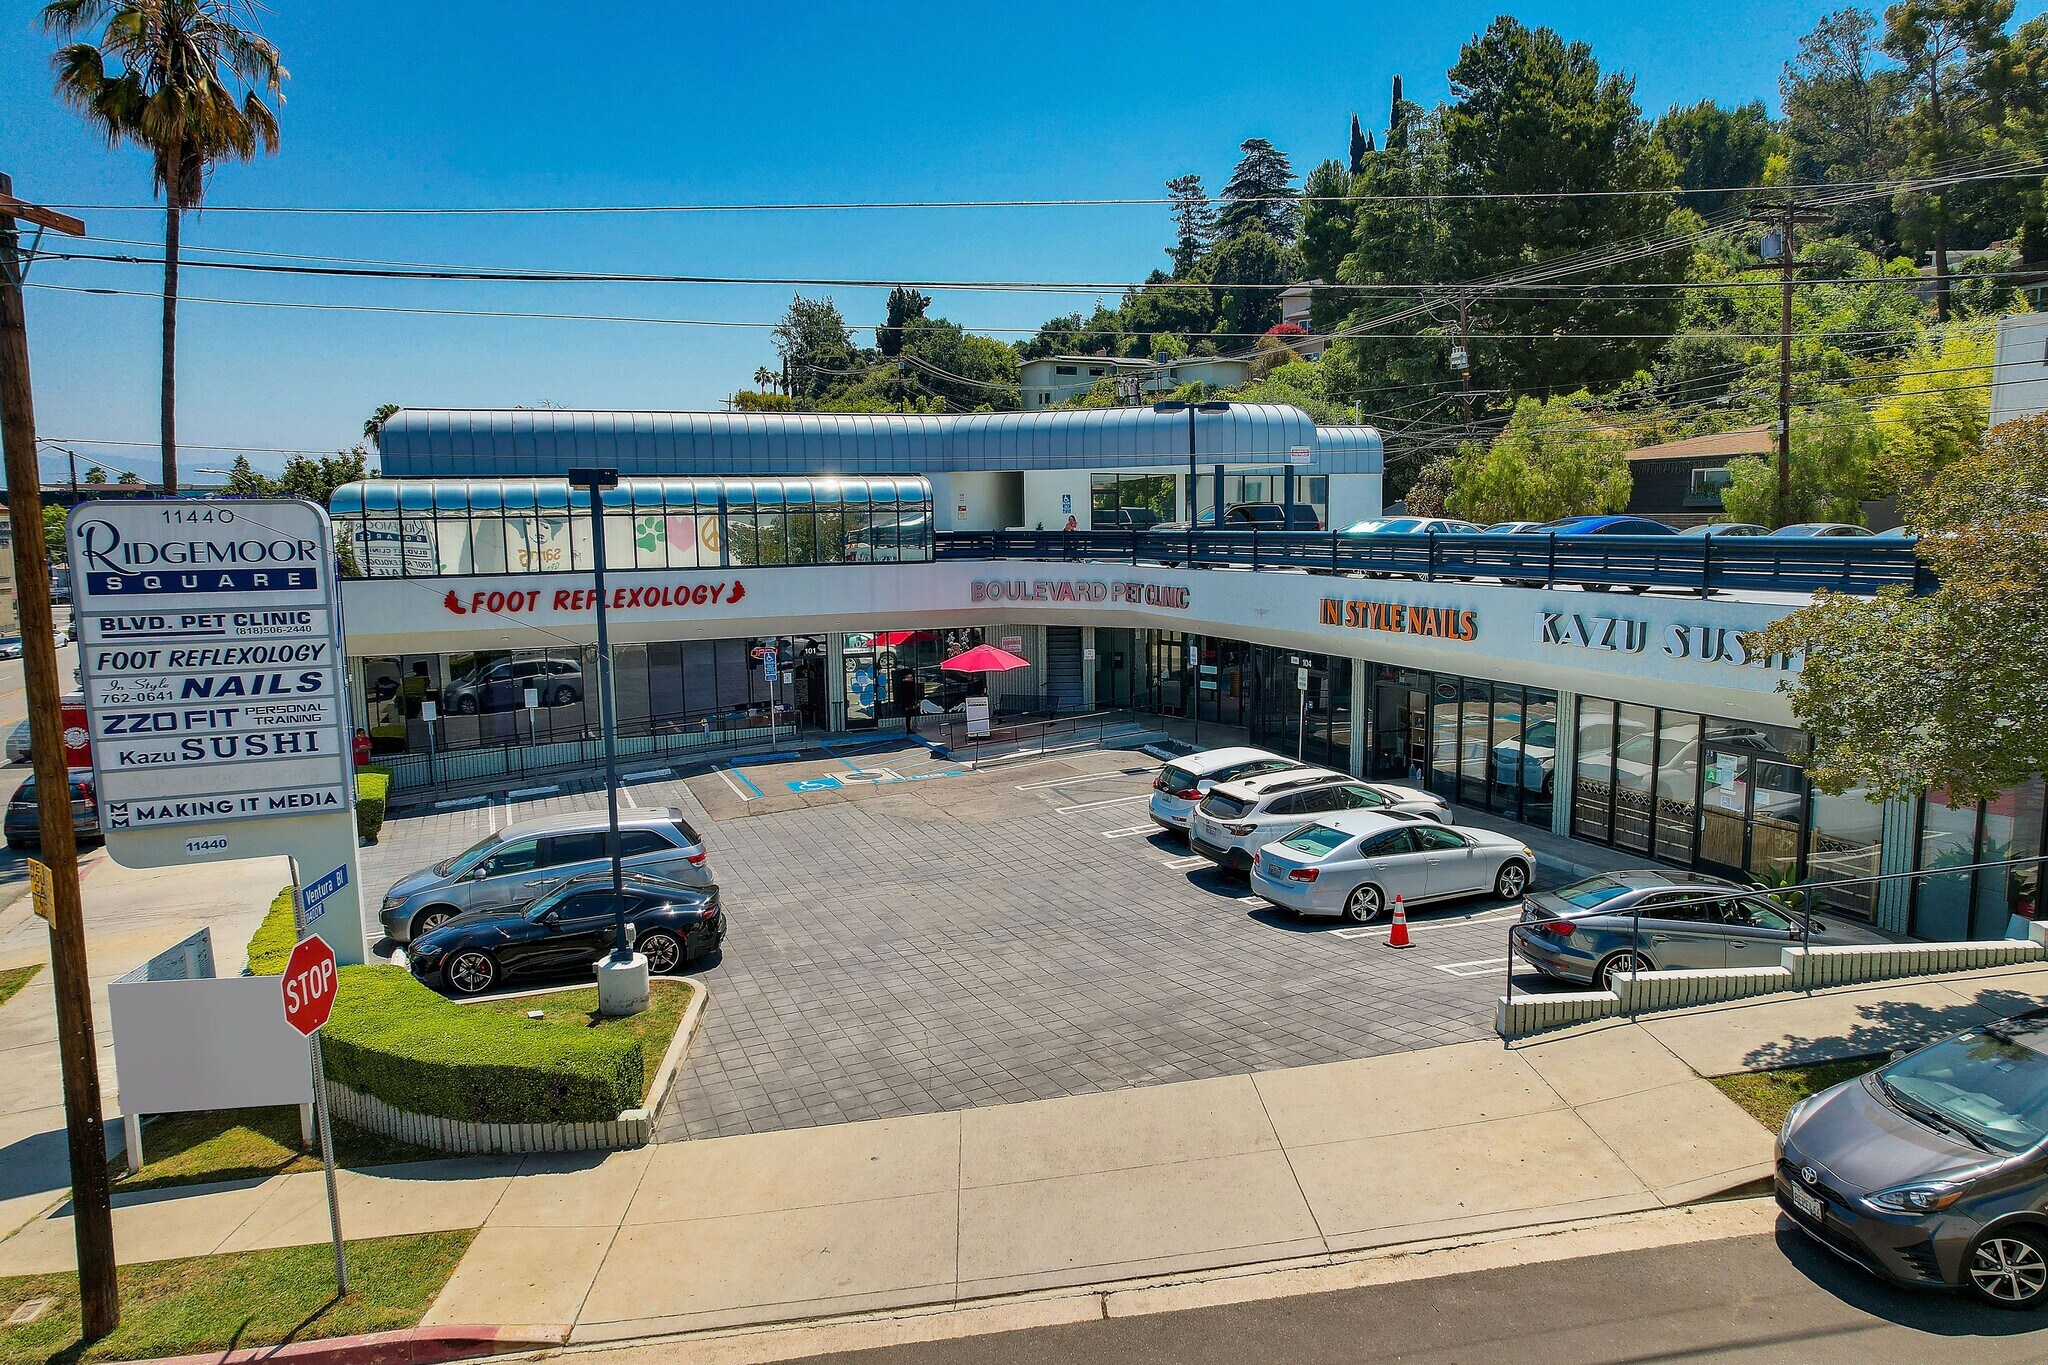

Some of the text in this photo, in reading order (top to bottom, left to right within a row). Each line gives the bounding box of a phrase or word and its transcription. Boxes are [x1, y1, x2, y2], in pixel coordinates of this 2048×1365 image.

[163, 509, 234, 524] 11440
[77, 519, 316, 576] RIDGEMOOR
[107, 573, 301, 591] SQUARE
[471, 590, 541, 613] FOOT
[970, 581, 1190, 609] BOULEVARD PET CLINIC
[101, 611, 311, 631] BLVD. PET CLINIC
[236, 625, 312, 635] (818)506-2440
[1319, 599, 1478, 641] IN STYLE NAILS
[1533, 612, 1647, 654] KAZU
[98, 643, 326, 670] FOOT REFLEXOLOGY
[103, 672, 323, 699] In Style NAILS
[101, 691, 173, 704] 762-0641
[245, 703, 328, 715] PERSONAL
[184, 708, 240, 729] FIT
[253, 713, 322, 725] TRAINING
[120, 731, 320, 765] Kazu SUSHI
[1707, 771, 1716, 780] A
[137, 800, 234, 820] MAKING
[240, 797, 259, 812] IT
[268, 791, 338, 809] MEDIA
[186, 838, 228, 852] 11440
[305, 869, 344, 906] Ventura Bl
[286, 958, 333, 1014] STOP
